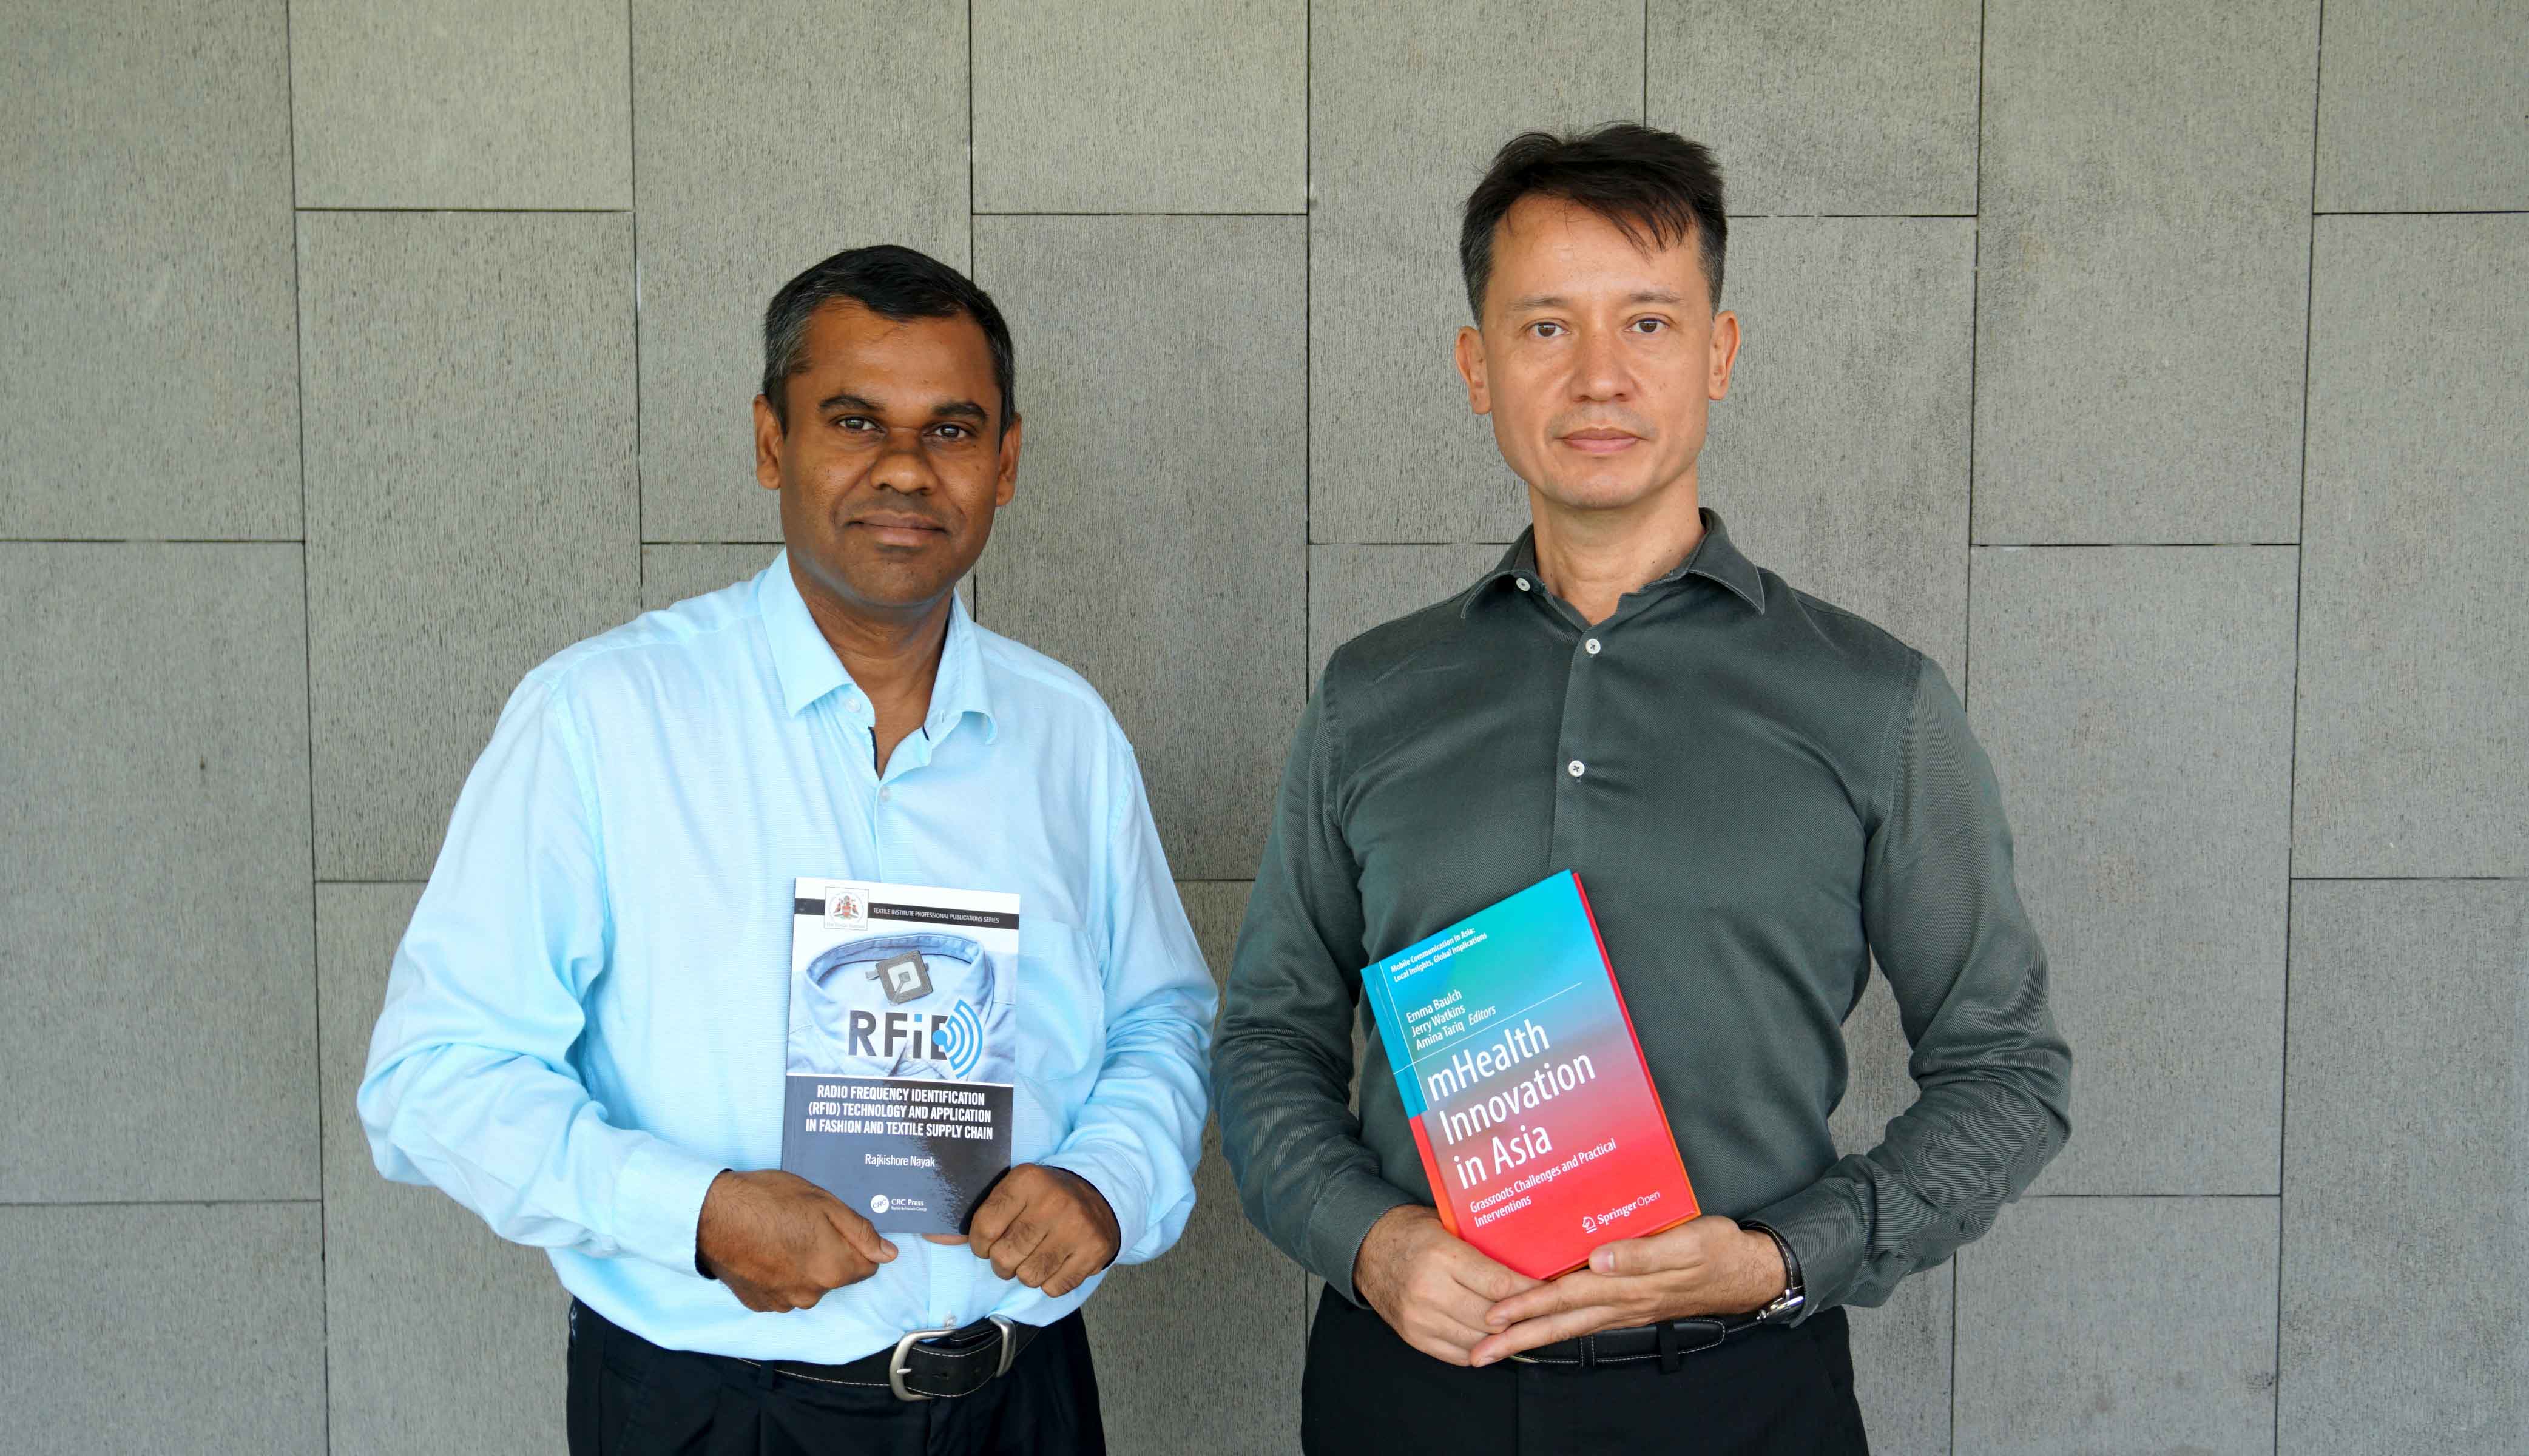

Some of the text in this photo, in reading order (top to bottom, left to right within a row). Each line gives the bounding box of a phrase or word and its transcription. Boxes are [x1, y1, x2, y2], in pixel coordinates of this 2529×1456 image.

[950, 914, 982, 922] PUBLICATIONS
[1390, 959, 1411, 973] Mobile
[1410, 938, 1454, 963] Communication
[1461, 928, 1476, 939] Asia:
[1394, 932, 1487, 982] Local Insights, Global Implications
[1406, 989, 1462, 1024] Emma Baulch
[1411, 1005, 1466, 1037] Jerry Watkins
[1416, 1005, 1496, 1051] Amina Tariq Editors
[1428, 1019, 1550, 1102] mHealth
[808, 1102, 991, 1122] (RFID) TECHNOLOGY AND APPLICATION
[817, 1085, 985, 1105] RADIO FREQUENCY IDENTIFICATION
[1439, 1054, 1596, 1145] Innovation
[806, 1119, 993, 1140] IN FASHION AND TEXTILE SUPPLY CHAIN
[865, 1154, 935, 1168] Rajkishore Nayak
[1454, 1125, 1552, 1189] in Asia
[1470, 1138, 1616, 1213] Grassroots Challenges and Practical
[1474, 1196, 1532, 1228] Interventions
